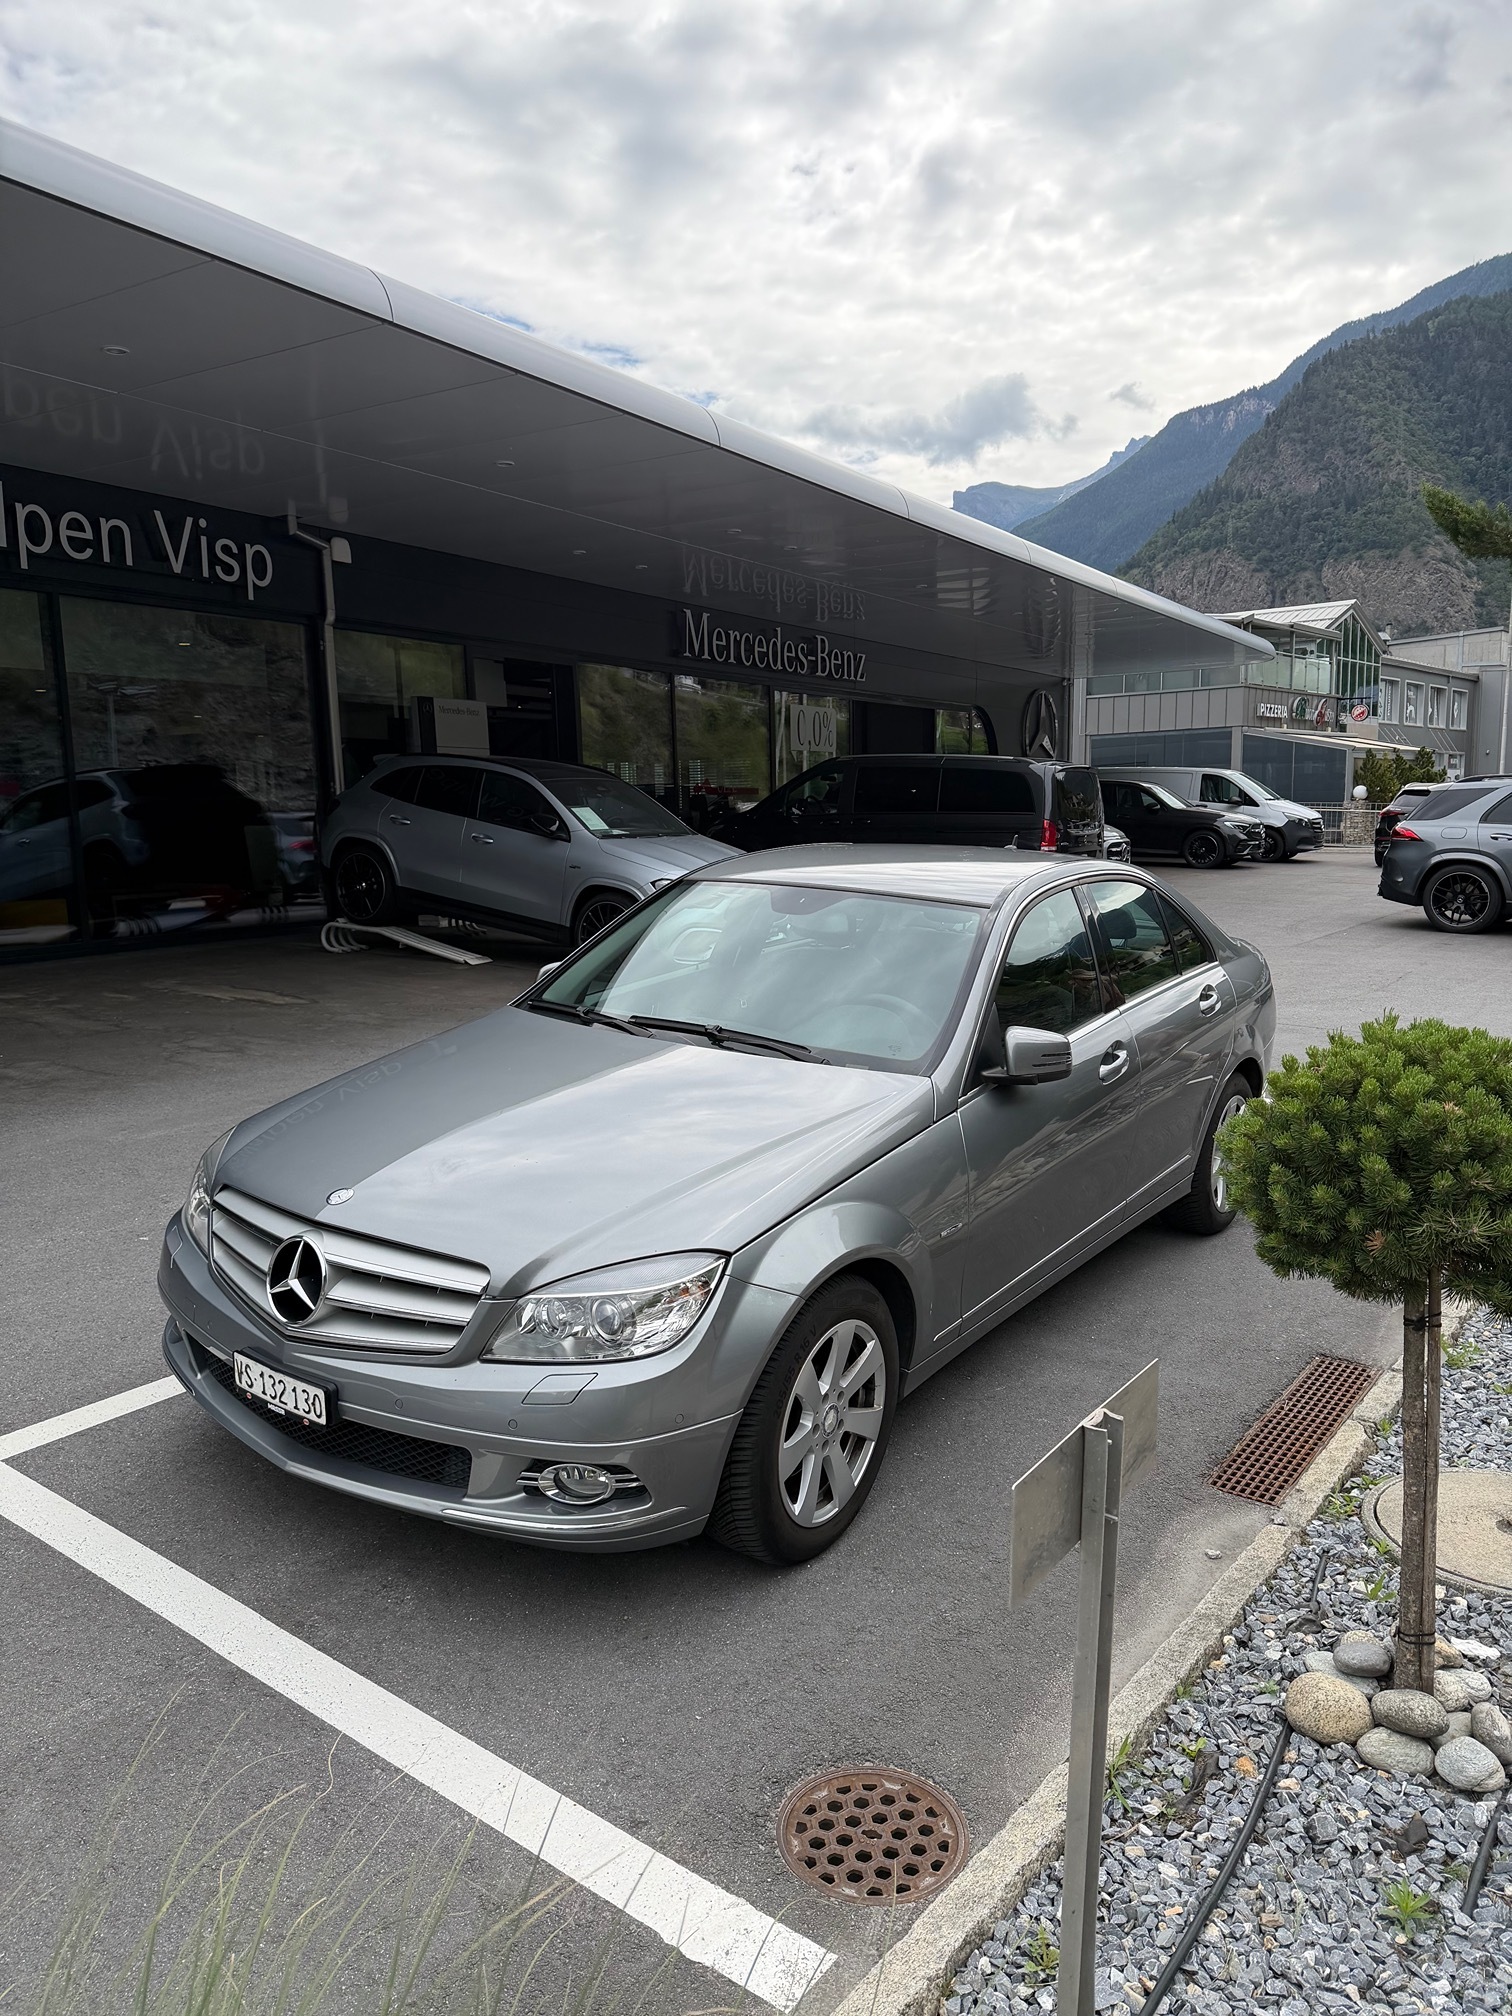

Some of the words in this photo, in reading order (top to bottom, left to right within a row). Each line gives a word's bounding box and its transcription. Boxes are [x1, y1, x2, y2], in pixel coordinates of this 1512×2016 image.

[153, 509, 274, 601] Visp
[683, 608, 867, 682] Mercedes-Benz
[1259, 702, 1289, 719] PIZZERIA
